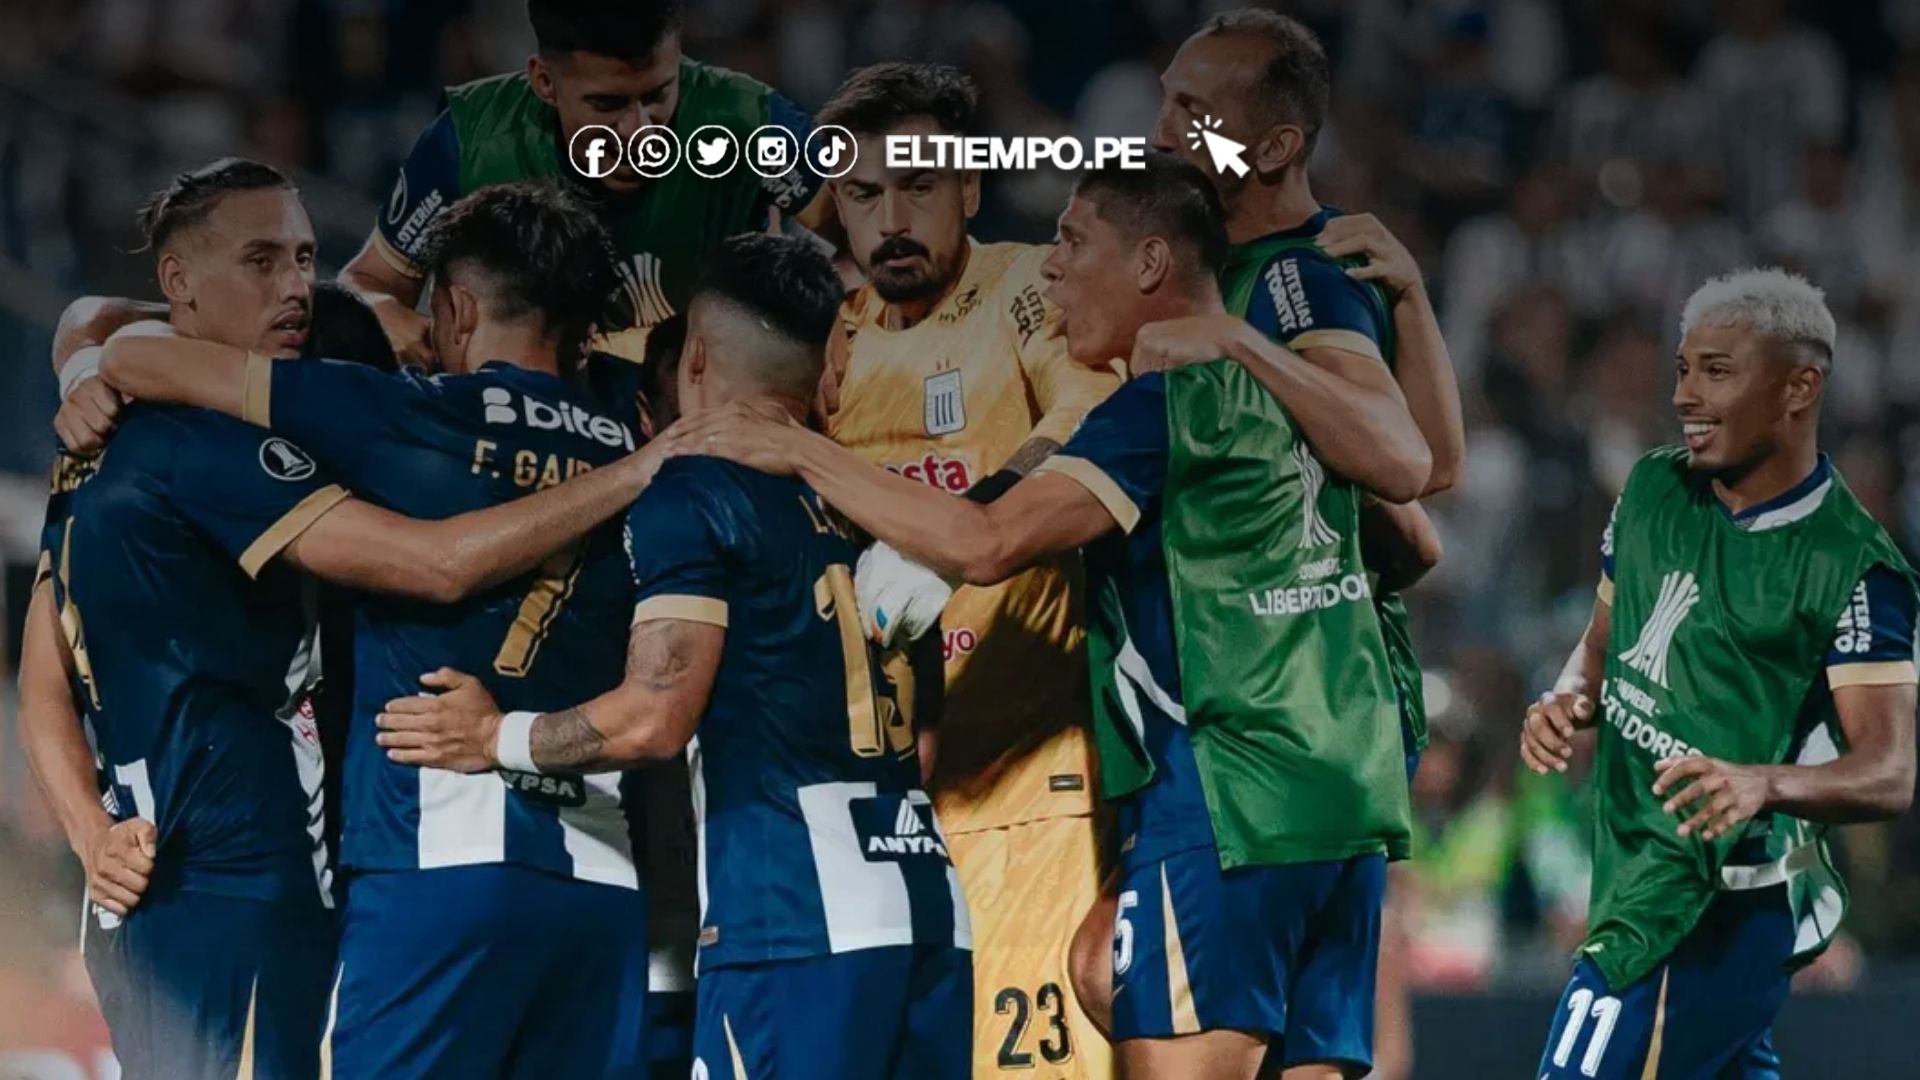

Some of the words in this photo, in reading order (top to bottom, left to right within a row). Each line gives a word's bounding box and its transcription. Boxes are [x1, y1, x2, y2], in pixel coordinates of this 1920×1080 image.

[470, 439, 501, 480] F.
[522, 394, 636, 453] bitel
[995, 982, 1075, 1070] 23
[1552, 987, 1623, 1079] 11
